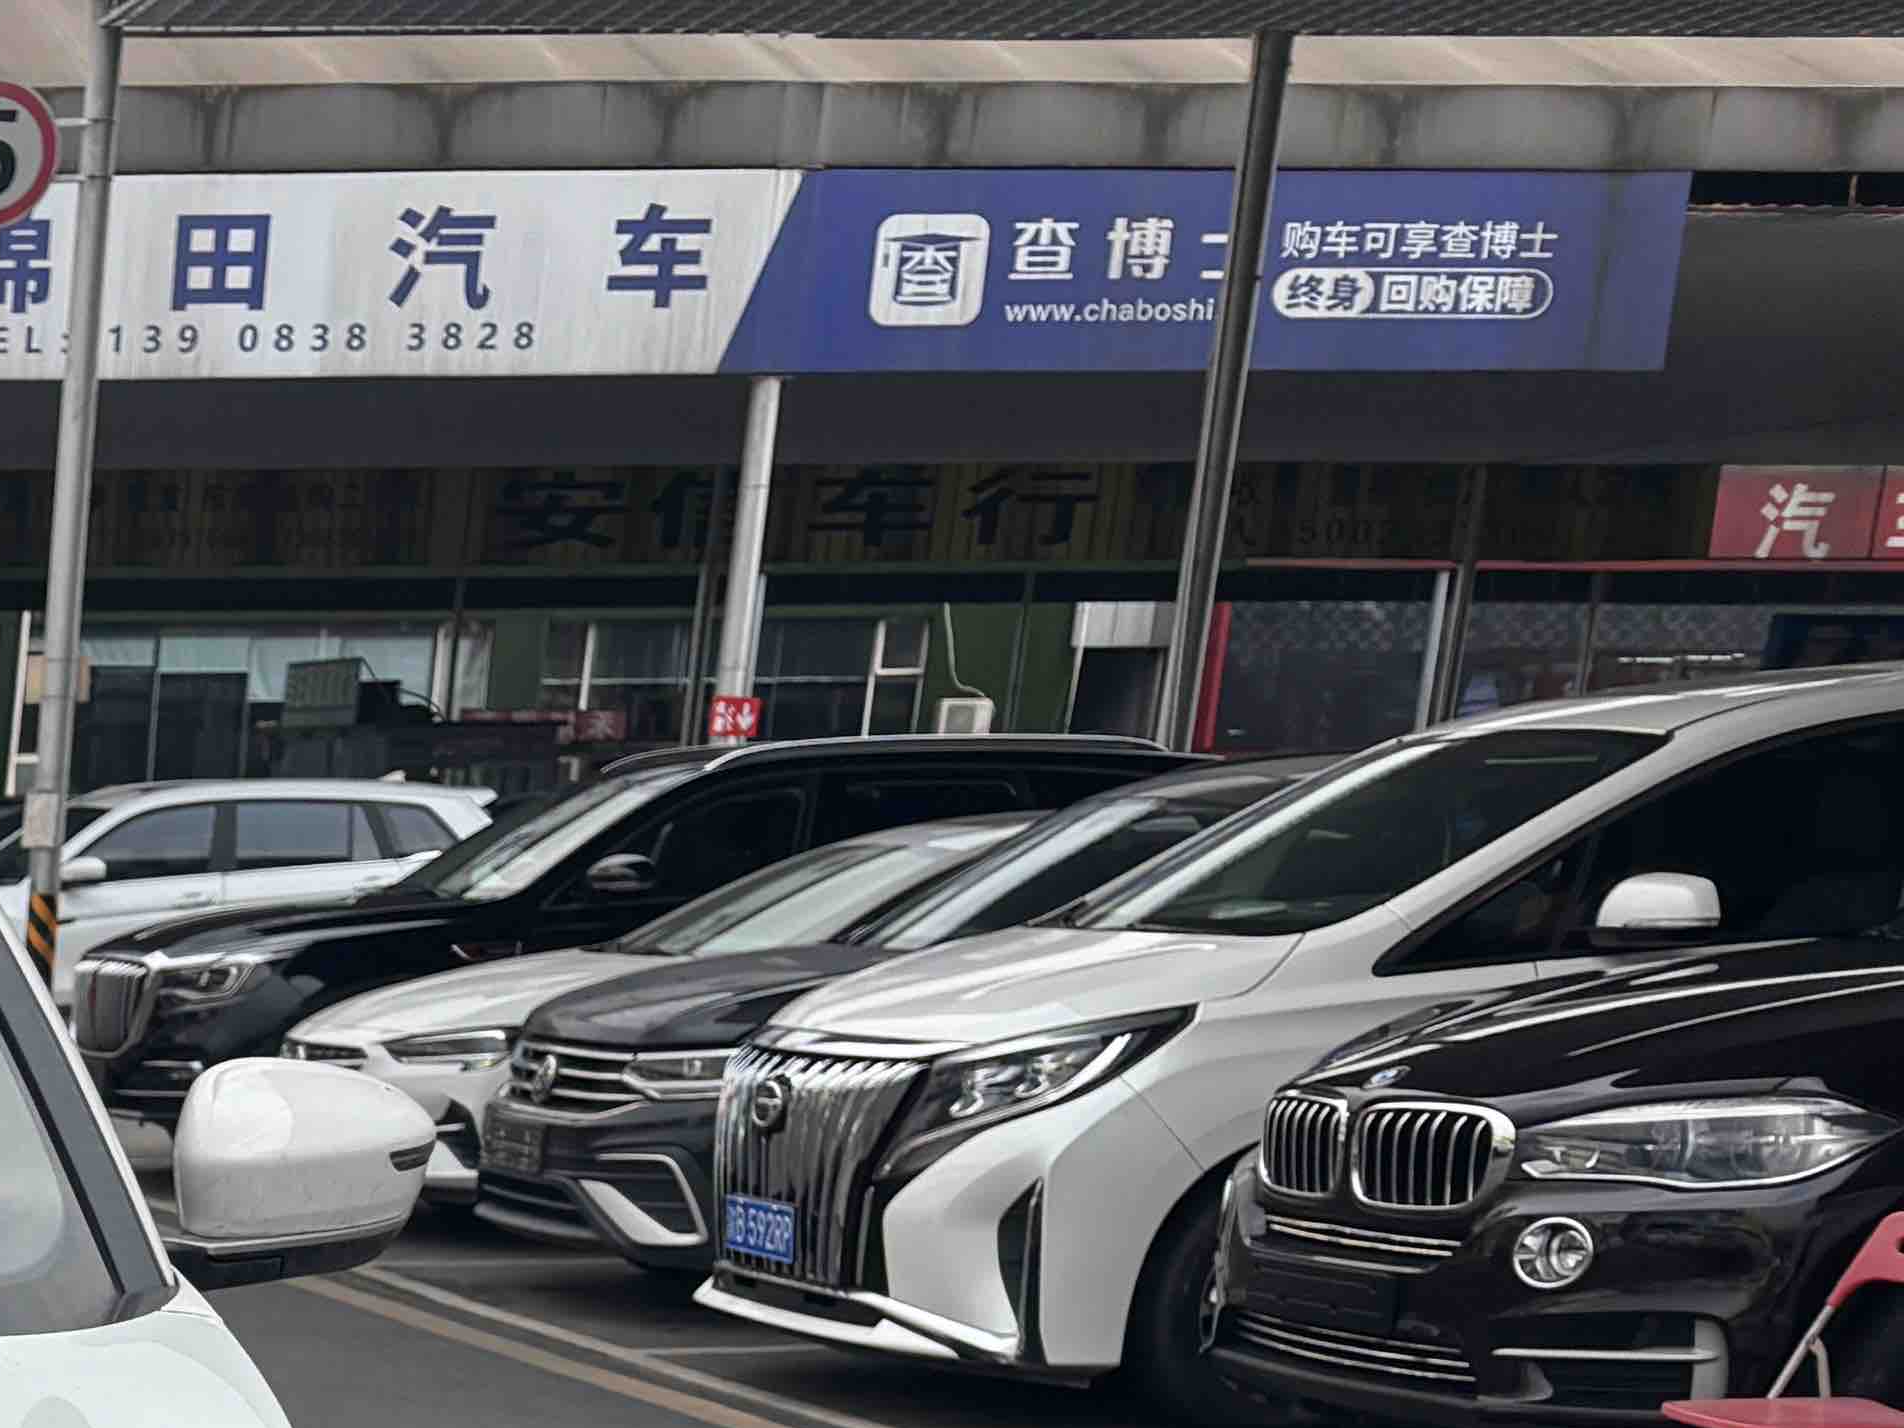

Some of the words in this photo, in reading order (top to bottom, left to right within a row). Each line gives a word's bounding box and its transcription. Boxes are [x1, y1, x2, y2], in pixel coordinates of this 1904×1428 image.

[1281, 220, 1559, 261] 购车可享查博士
[1004, 297, 1216, 324] www.chaboshi
[108, 323, 199, 355] 139
[238, 321, 369, 355] 0838
[406, 320, 538, 353] 3828
